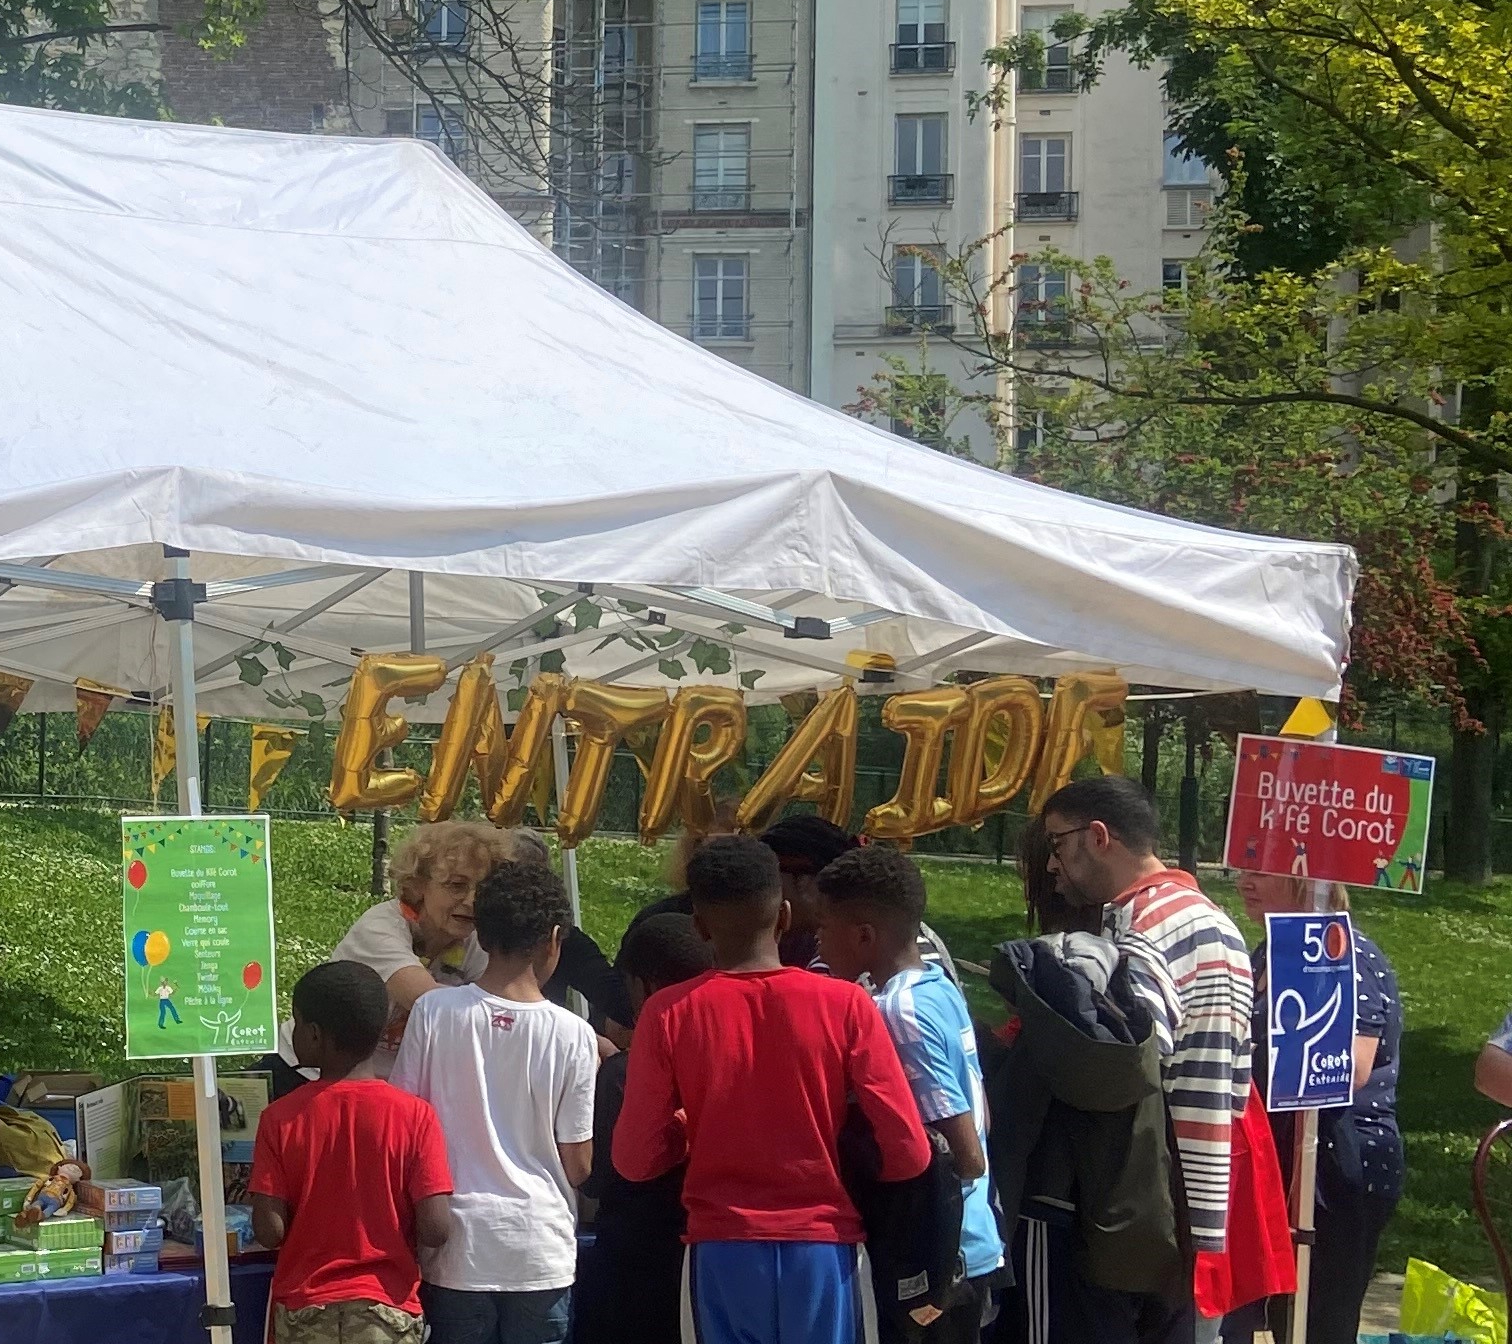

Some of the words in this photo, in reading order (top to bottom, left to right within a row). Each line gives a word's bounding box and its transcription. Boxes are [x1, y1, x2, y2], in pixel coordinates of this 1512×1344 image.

[1257, 771, 1355, 809] Buvette
[1365, 784, 1393, 814] du
[1322, 808, 1396, 845] Corot
[218, 866, 237, 876] Corot
[1302, 921, 1347, 963] 50
